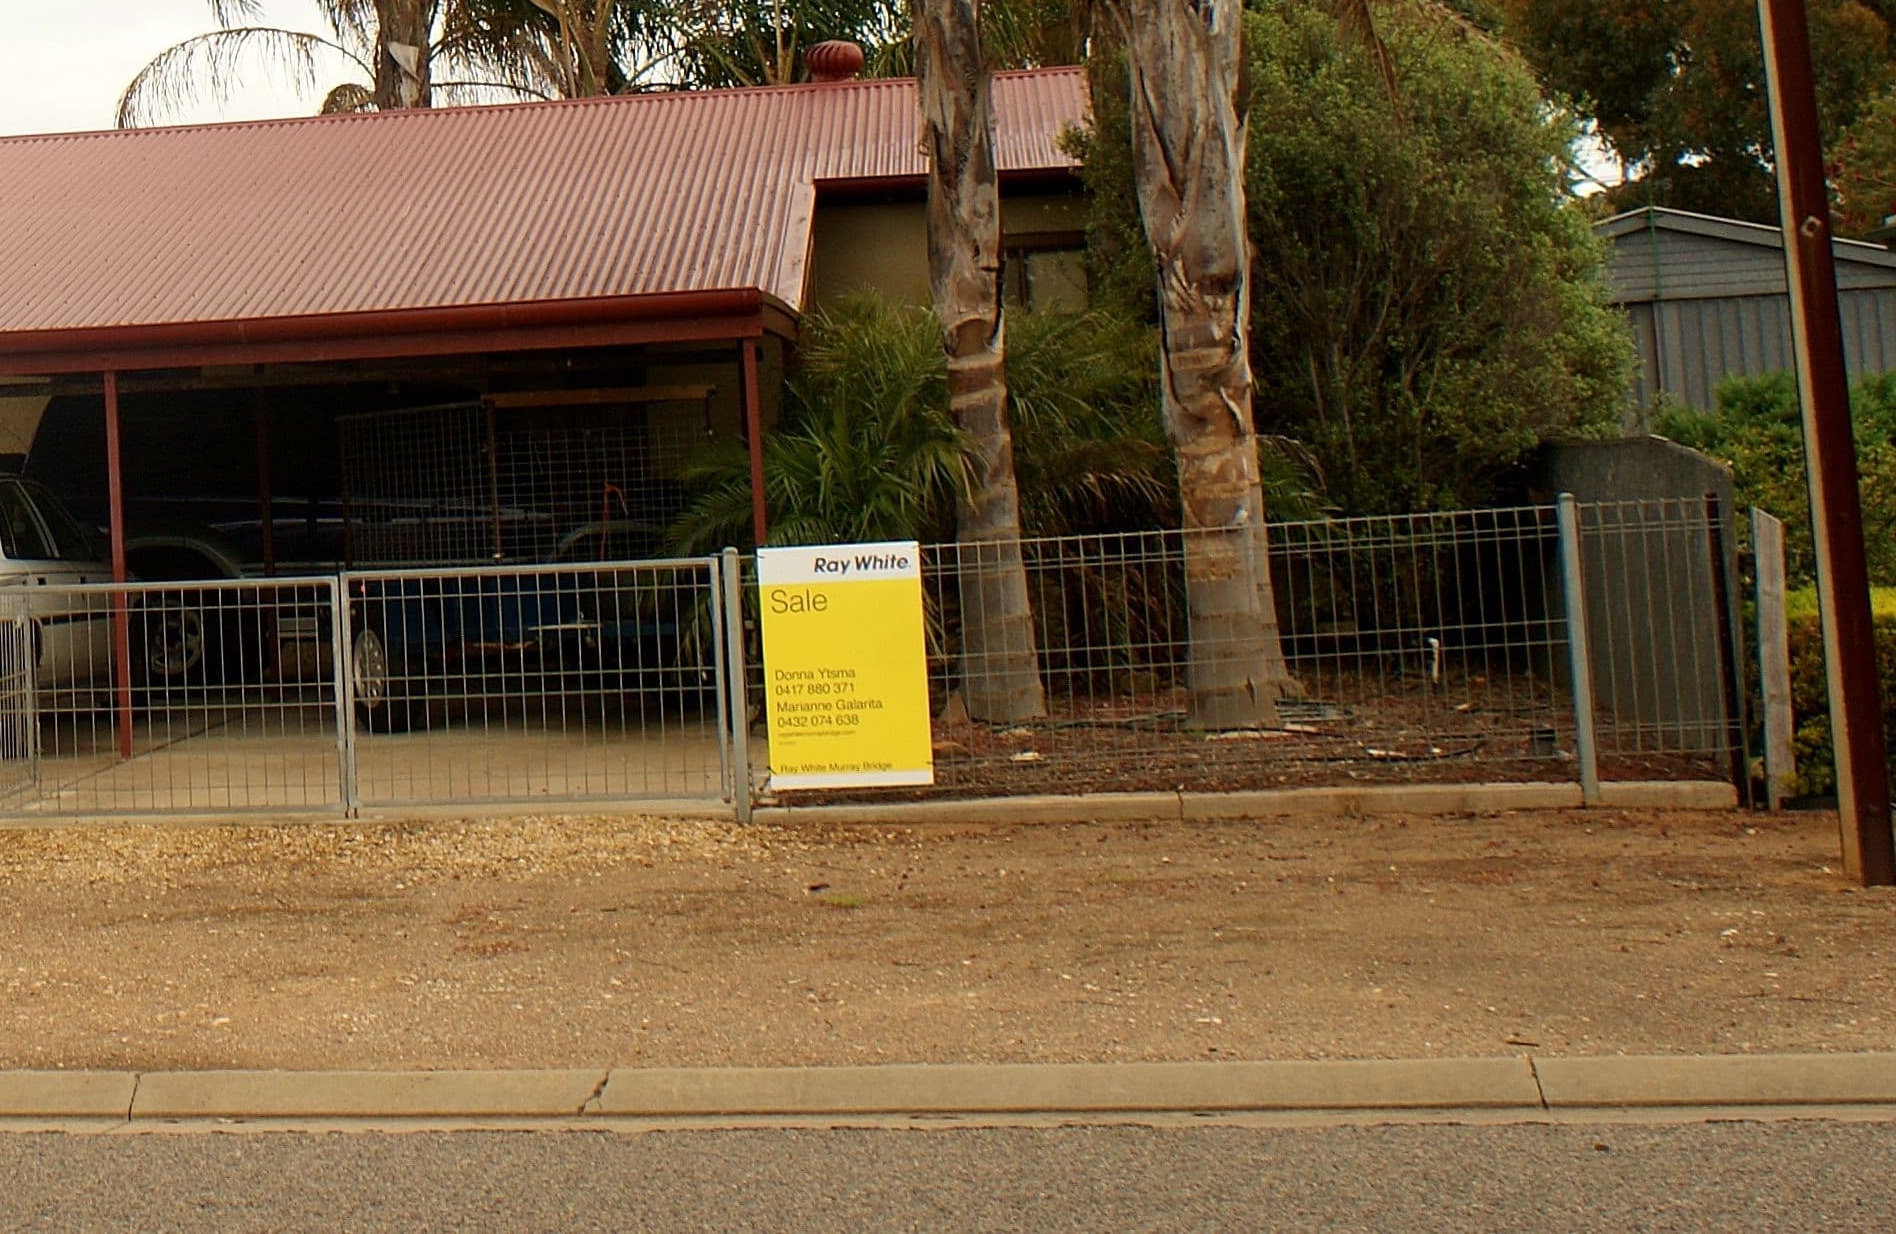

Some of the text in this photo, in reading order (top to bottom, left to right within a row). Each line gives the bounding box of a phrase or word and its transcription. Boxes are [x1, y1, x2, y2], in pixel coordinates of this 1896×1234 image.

[814, 554, 908, 575] Ray White
[771, 589, 828, 614] Sale
[775, 669, 814, 681] Donna
[775, 684, 804, 696] 0417
[833, 682, 855, 694] 371
[777, 701, 832, 713] Marianne
[777, 714, 859, 728] 0432 074 638
[800, 764, 827, 773] White
